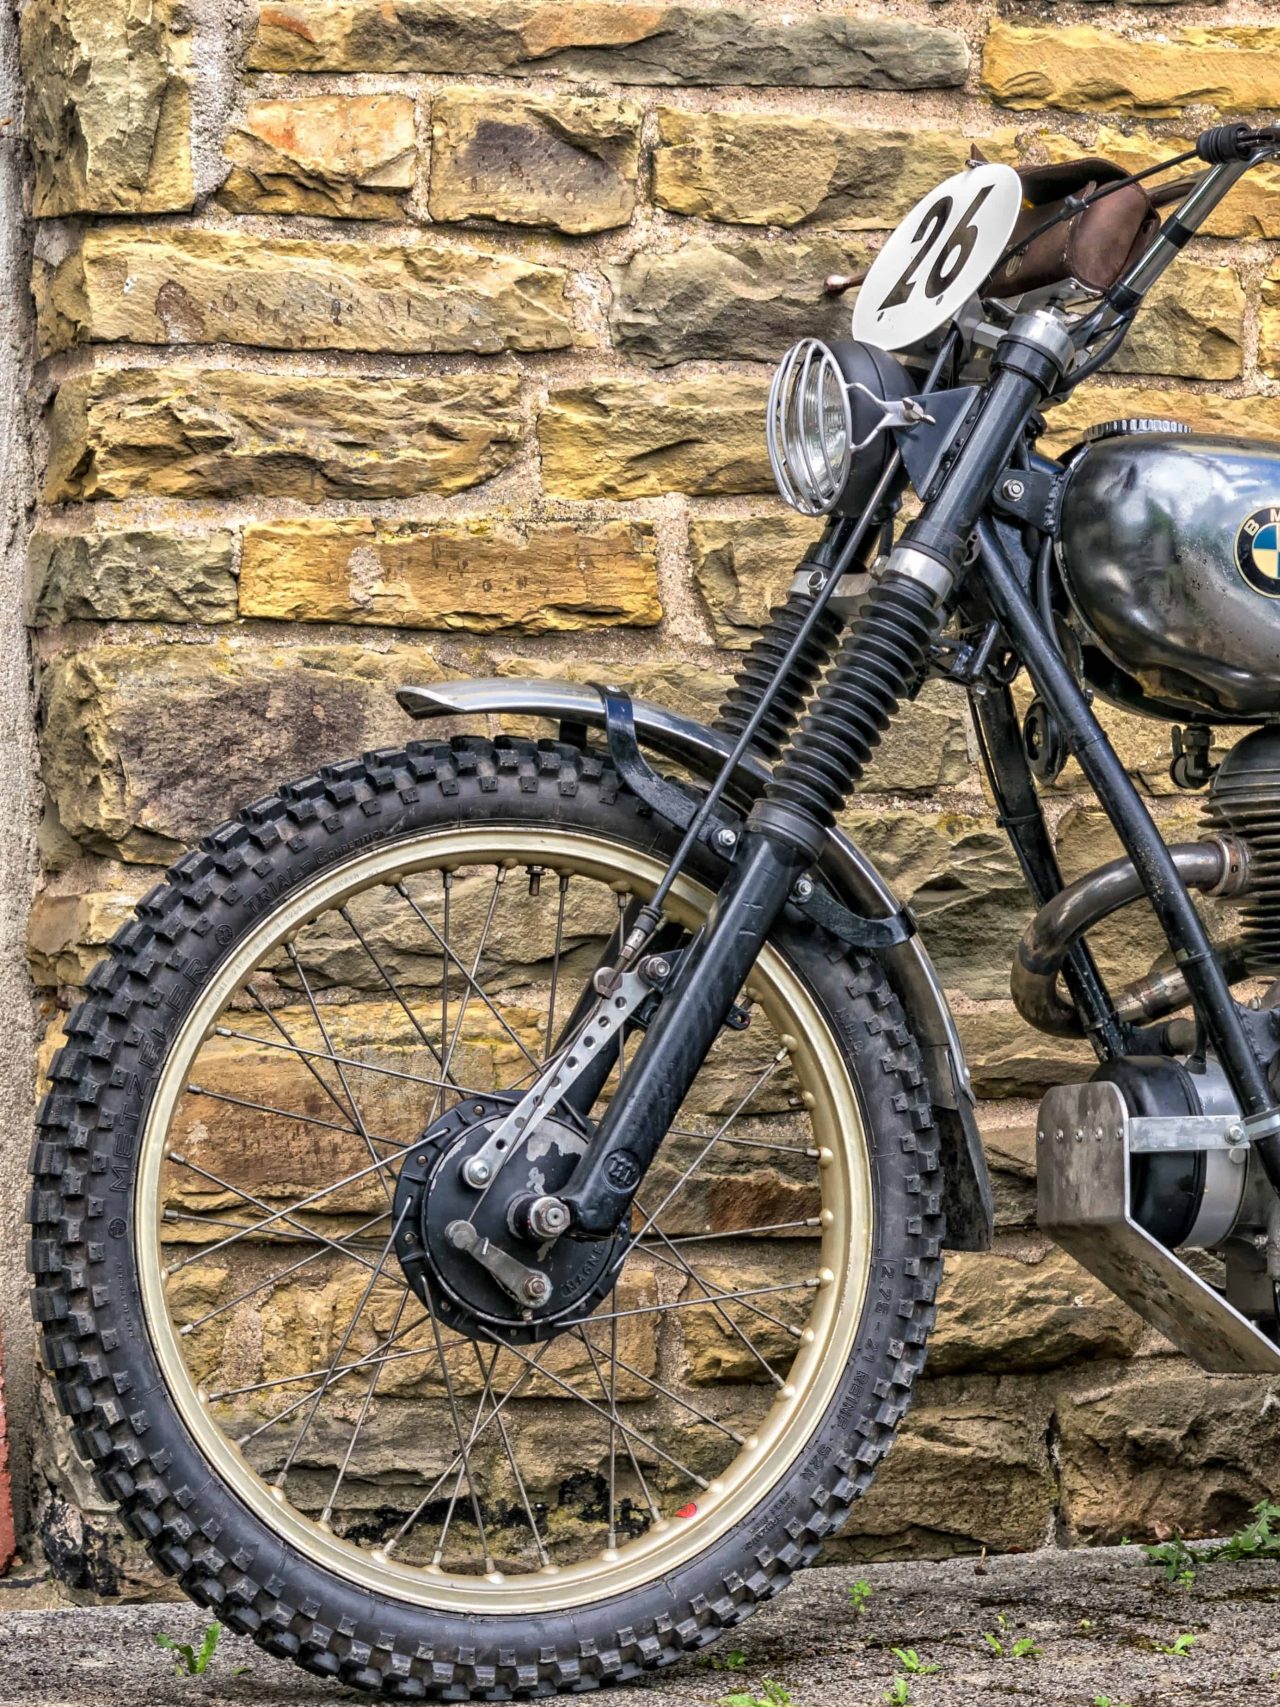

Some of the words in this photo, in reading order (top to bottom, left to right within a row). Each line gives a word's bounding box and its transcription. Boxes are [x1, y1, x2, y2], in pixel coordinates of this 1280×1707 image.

[878, 184, 995, 311] 26
[109, 957, 209, 1192] METZELER
[873, 1264, 897, 1316] 2.75
[860, 1336, 882, 1365] 21
